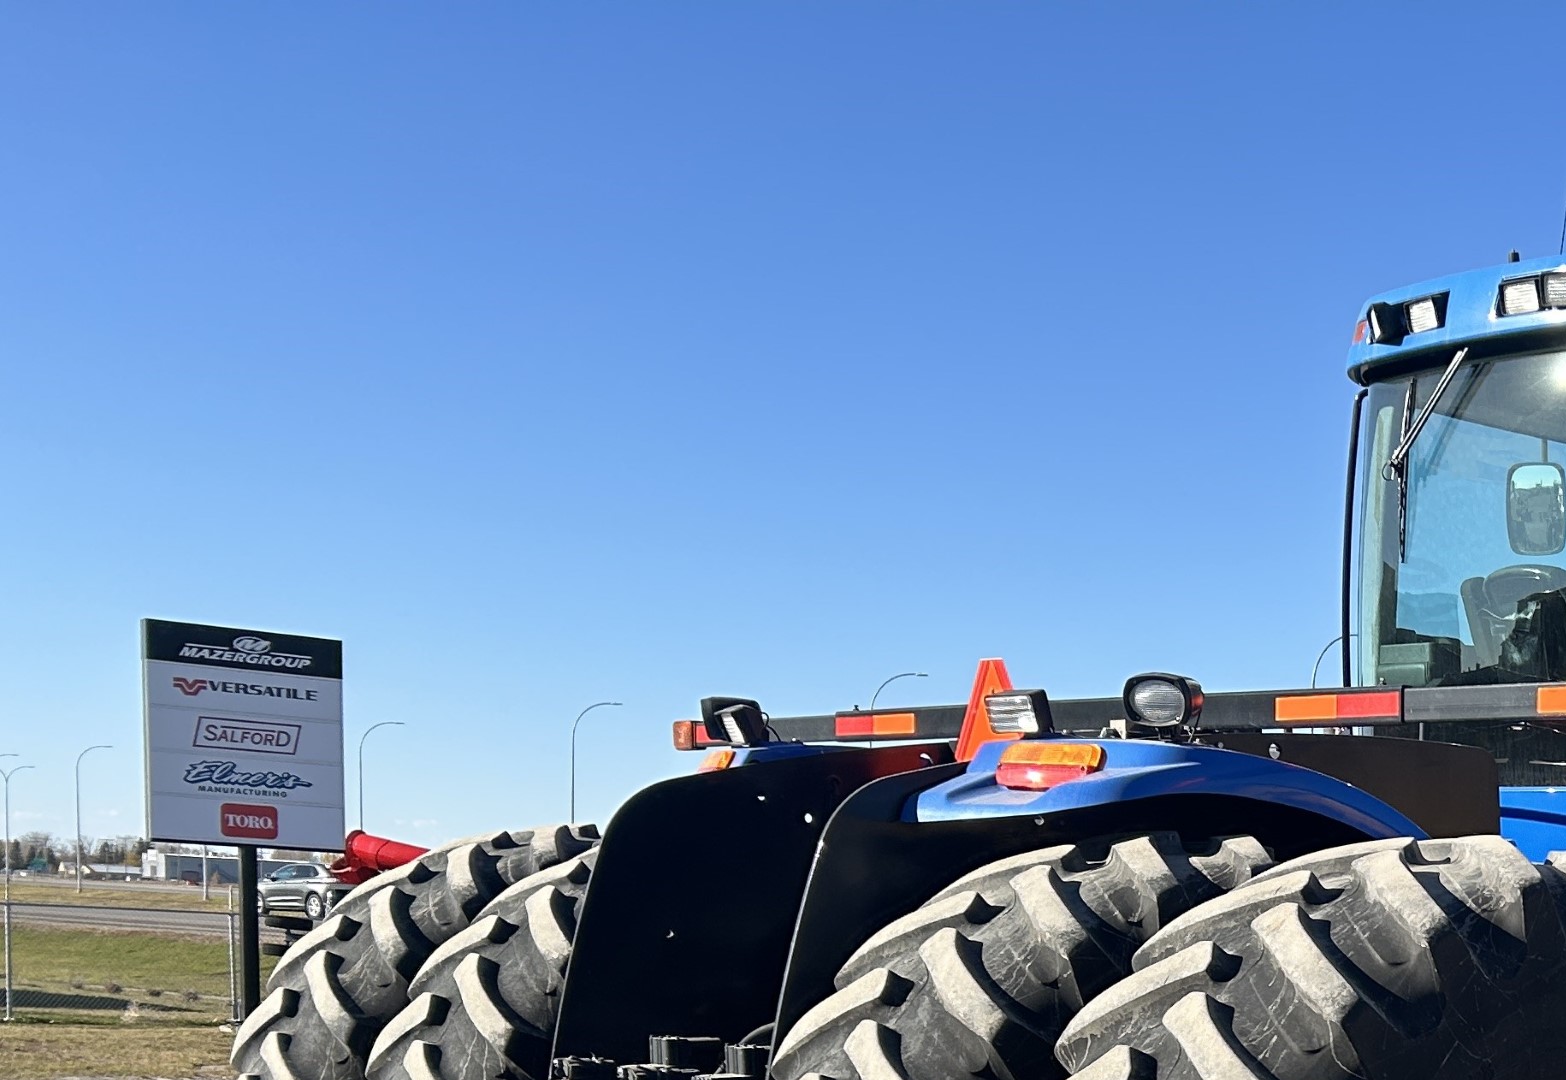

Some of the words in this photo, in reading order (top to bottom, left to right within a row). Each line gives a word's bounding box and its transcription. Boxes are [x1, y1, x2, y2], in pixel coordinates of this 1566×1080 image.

[179, 646, 311, 668] MAZERGROUP
[209, 680, 317, 701] VERSATILE
[203, 724, 291, 747] SALFORD
[183, 760, 312, 789] Elmer's
[198, 785, 287, 797] MANUFACTURING
[224, 813, 273, 829] TORO
